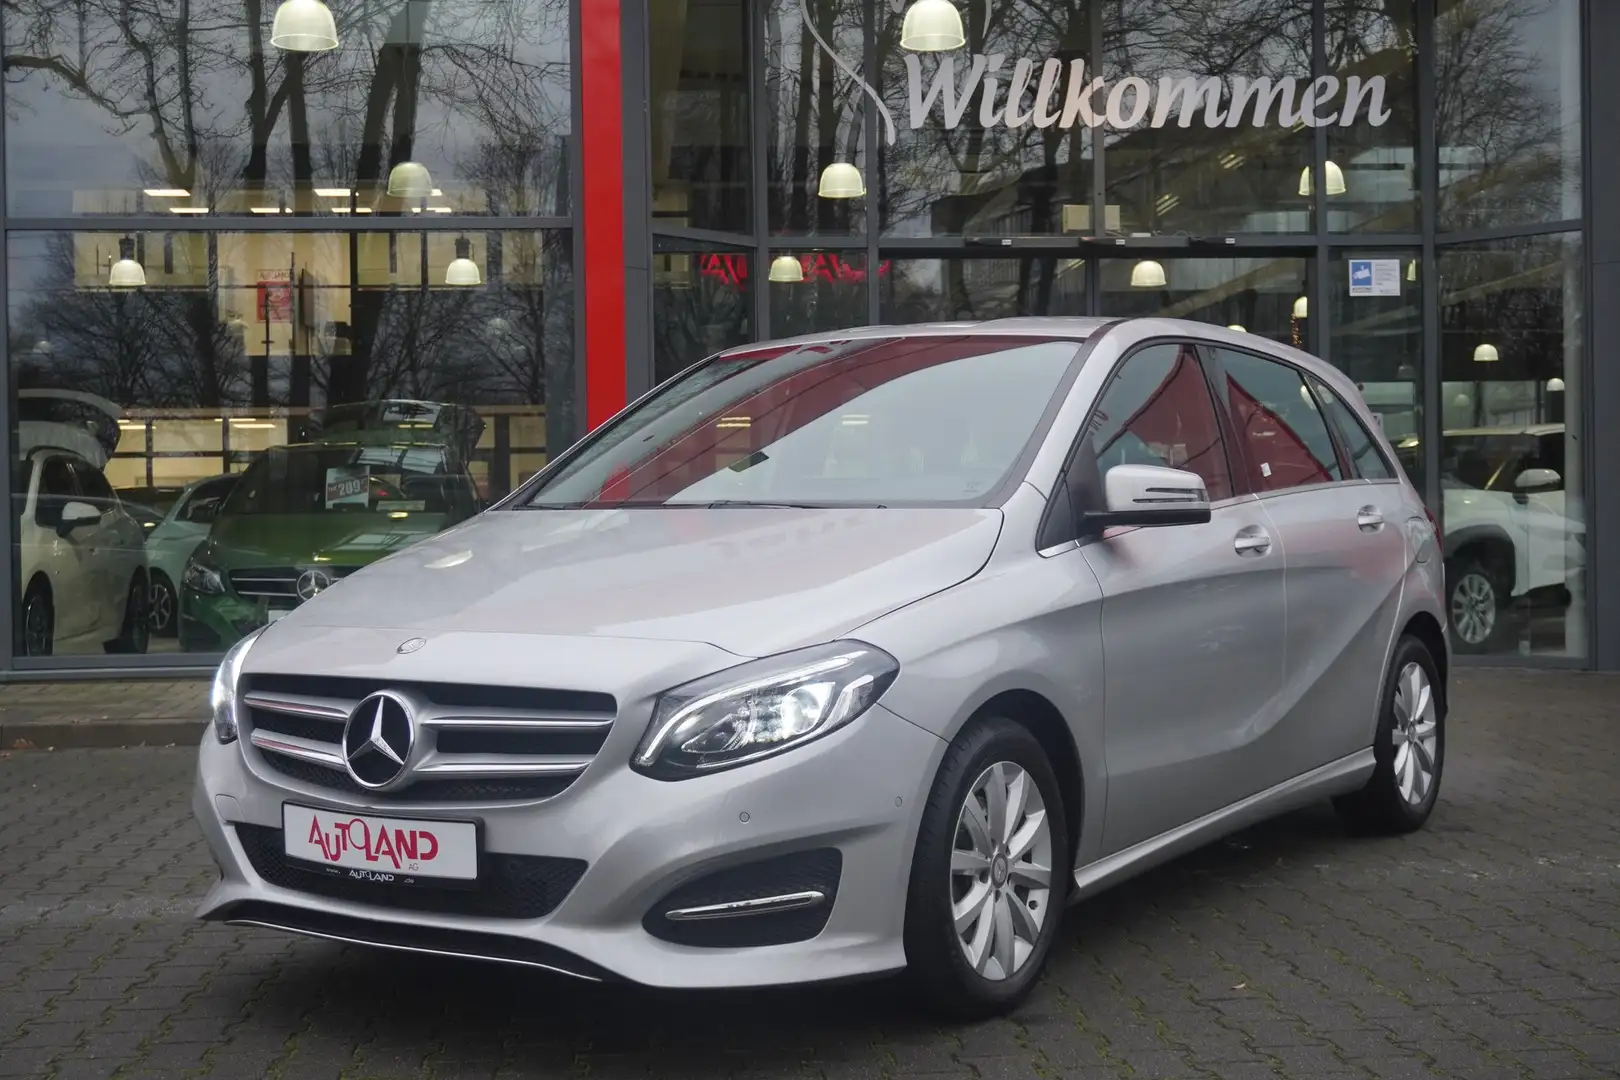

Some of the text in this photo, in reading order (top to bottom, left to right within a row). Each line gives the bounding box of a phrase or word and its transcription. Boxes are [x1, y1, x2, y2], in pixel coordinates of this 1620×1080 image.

[904, 53, 1392, 129] Willkommen
[308, 814, 439, 869] AUTOLAND
[348, 869, 395, 882] AUTOLAND
[408, 863, 419, 872] AG
